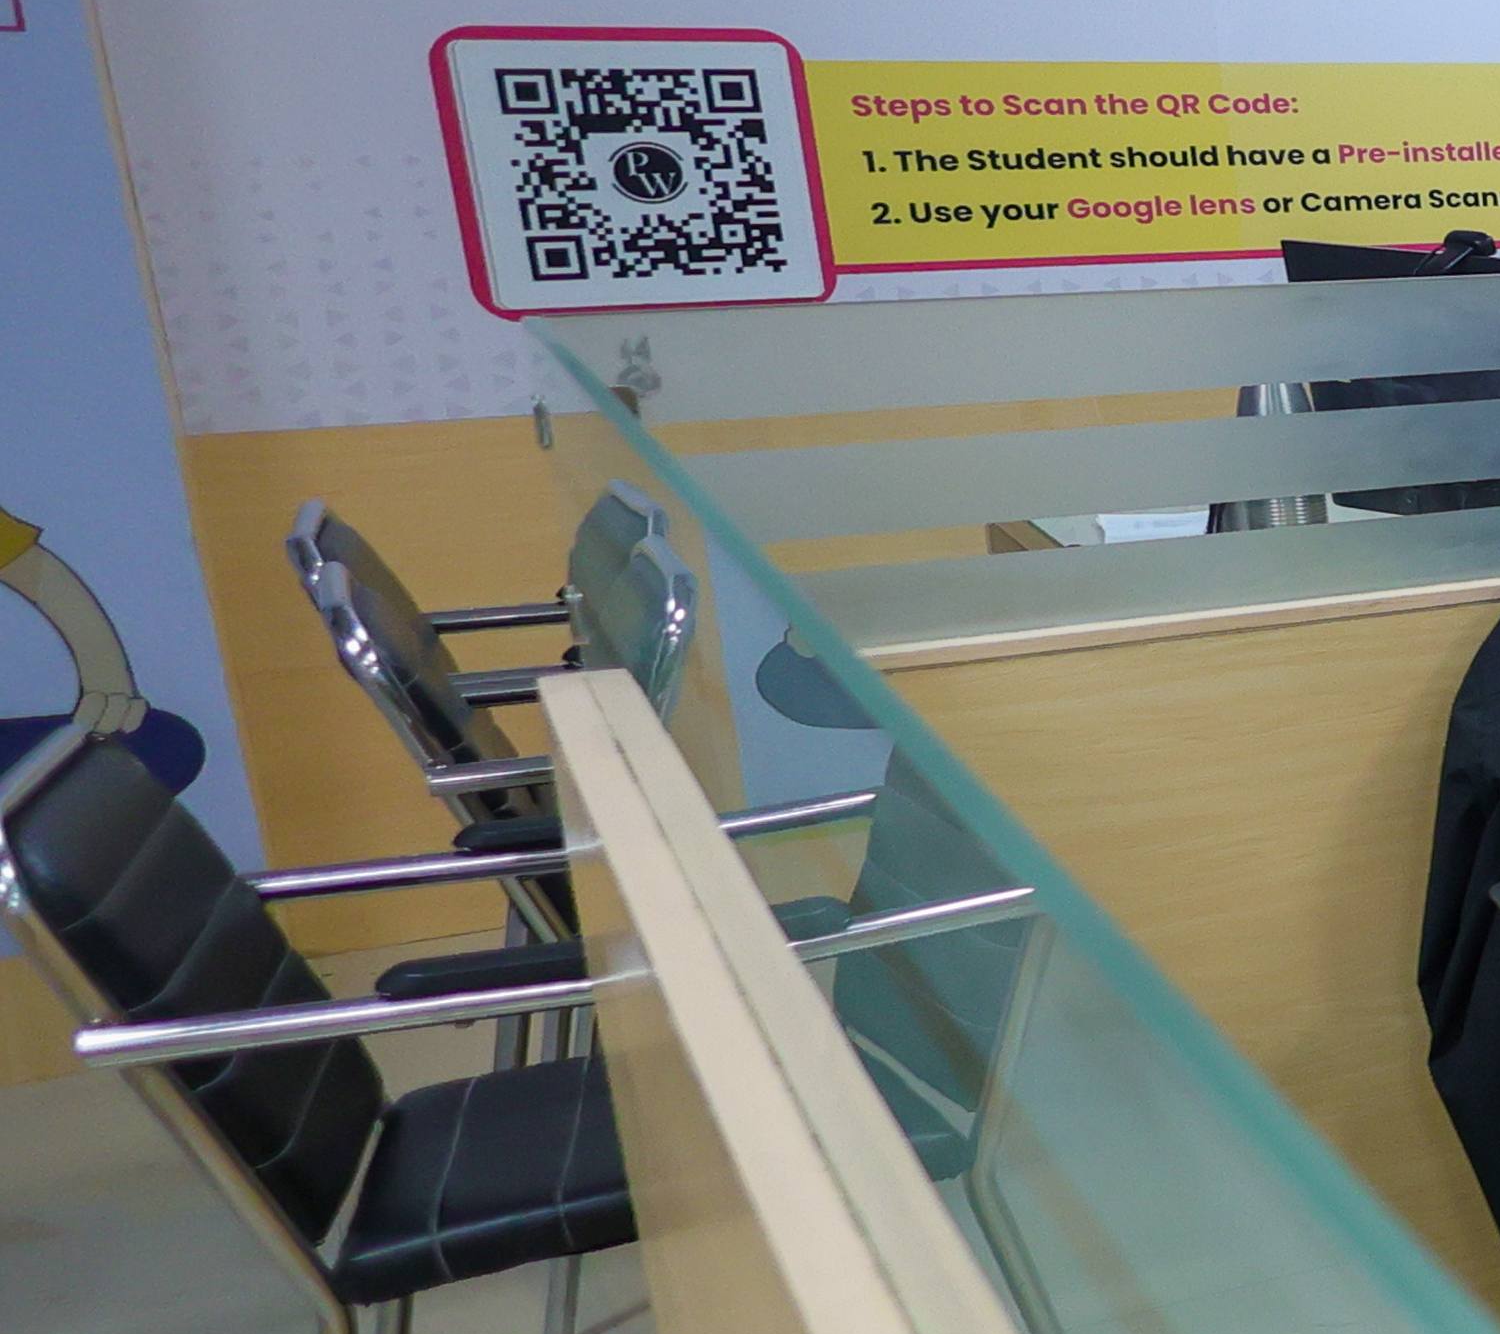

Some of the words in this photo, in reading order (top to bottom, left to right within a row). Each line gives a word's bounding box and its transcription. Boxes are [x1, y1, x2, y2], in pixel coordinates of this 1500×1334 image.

[850, 94, 953, 125] Steps
[958, 94, 996, 117] to
[1001, 93, 1088, 117] Scan
[1093, 92, 1150, 116] the
[1155, 93, 1201, 118] QR
[1207, 92, 1299, 115] Code:
[861, 149, 888, 174] 1.
[892, 148, 960, 173] The
[965, 147, 1103, 172] Student
[1109, 144, 1220, 169] should
[1225, 144, 1306, 167] have
[1311, 147, 1332, 166] a
[870, 201, 903, 226] 2.
[908, 201, 974, 224] Use
[979, 202, 1060, 230] your
[1066, 195, 1183, 225] Google
[1189, 194, 1257, 216] lens
[1262, 196, 1294, 214] or
[1300, 192, 1423, 213] Camera
